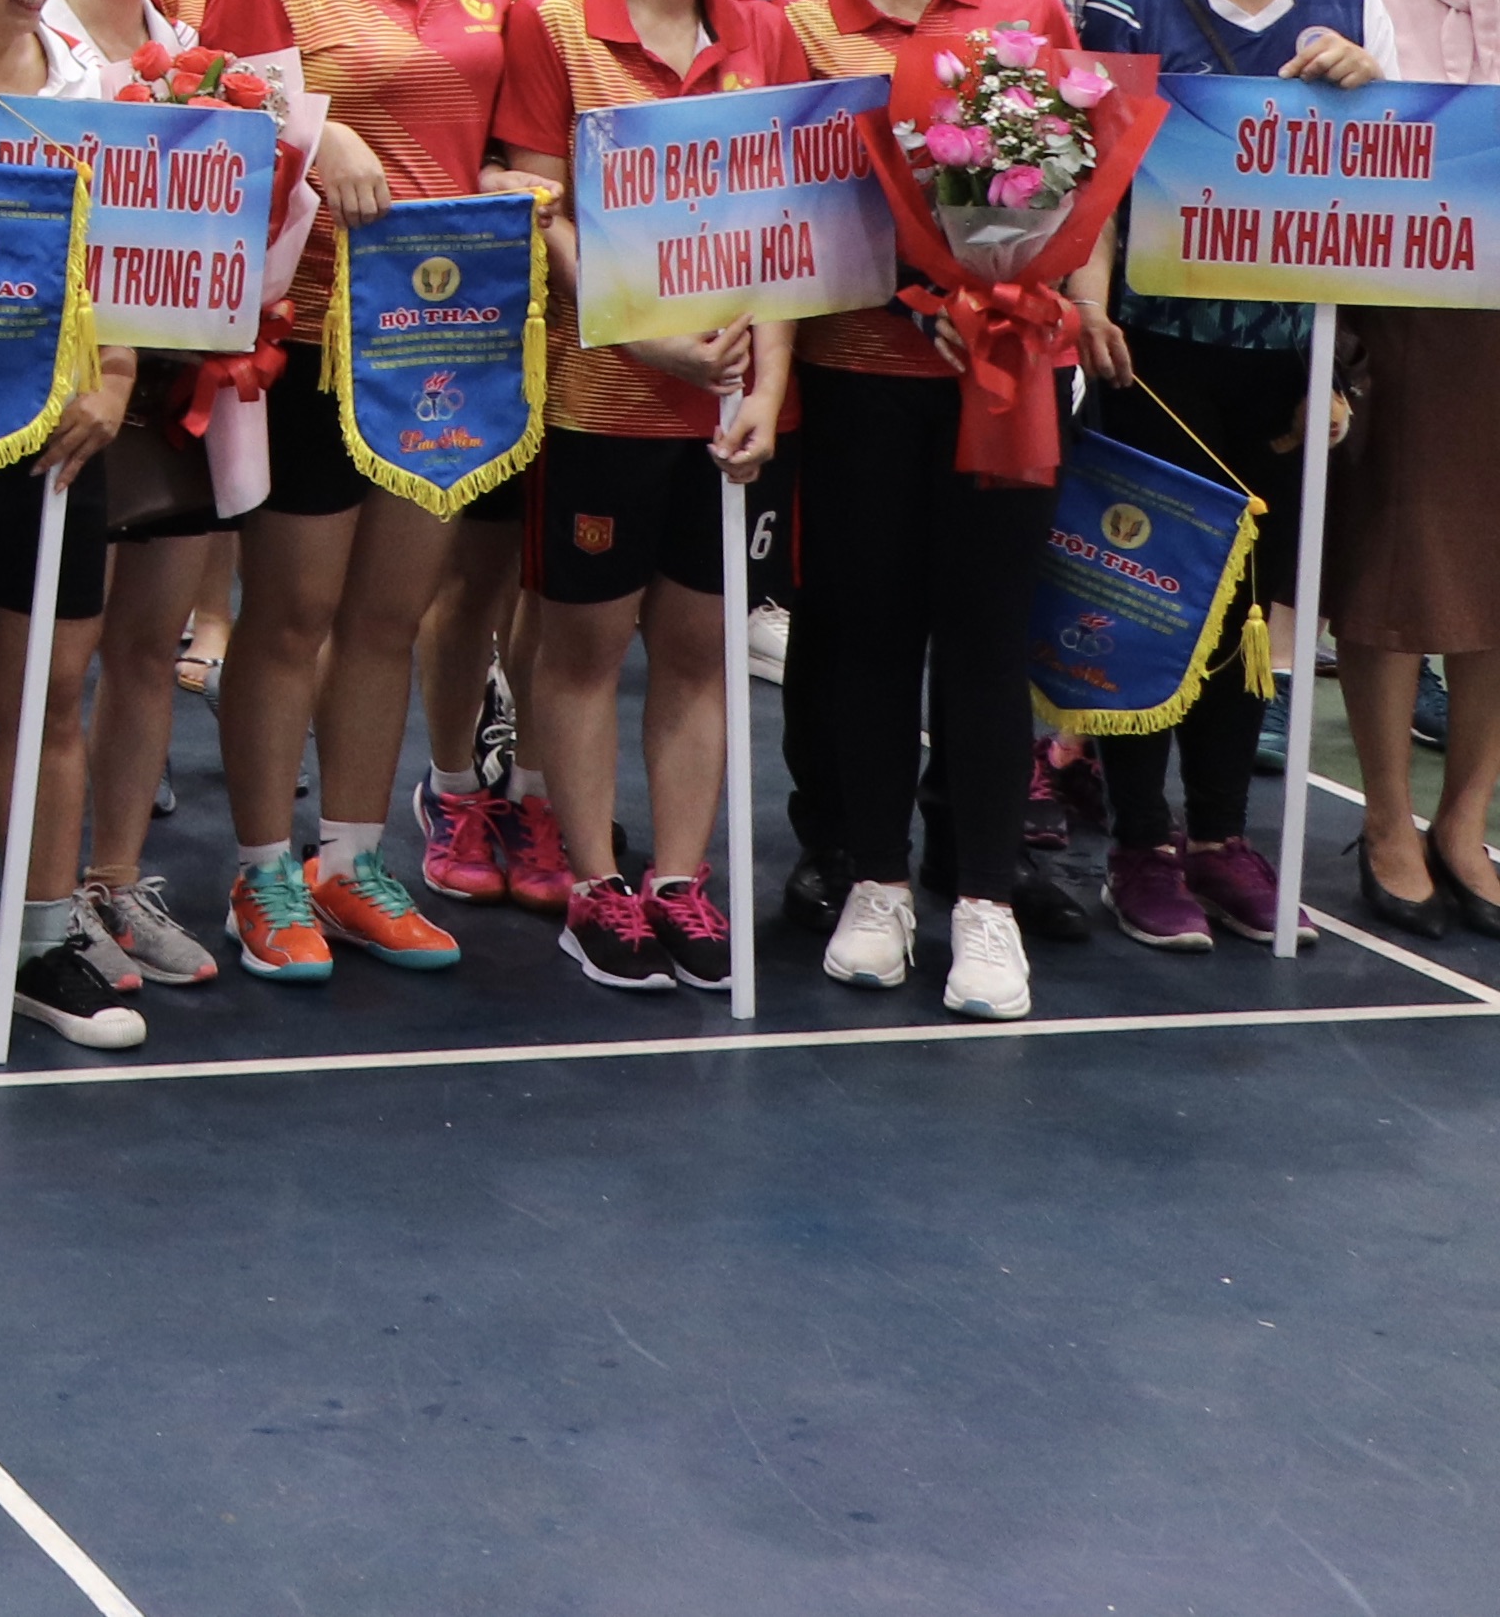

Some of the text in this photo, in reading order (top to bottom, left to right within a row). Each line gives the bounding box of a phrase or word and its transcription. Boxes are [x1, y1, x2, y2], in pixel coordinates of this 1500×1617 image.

[101, 137, 159, 211] NHÀ
[166, 139, 244, 216] NƯỚC
[603, 109, 870, 211] KHO BẠC NHÀ NƯỚC
[1236, 99, 1434, 179] SỞ TÀI CHÍNH
[658, 209, 815, 297] KHÁNH HÒA
[1180, 187, 1475, 270] TỈNH KHÁNH HÒA
[113, 244, 201, 310] TRUNG
[209, 239, 245, 324] BỘ
[379, 306, 500, 331] HỘI THAO
[750, 510, 776, 560] 6
[1101, 550, 1180, 594] THAO
